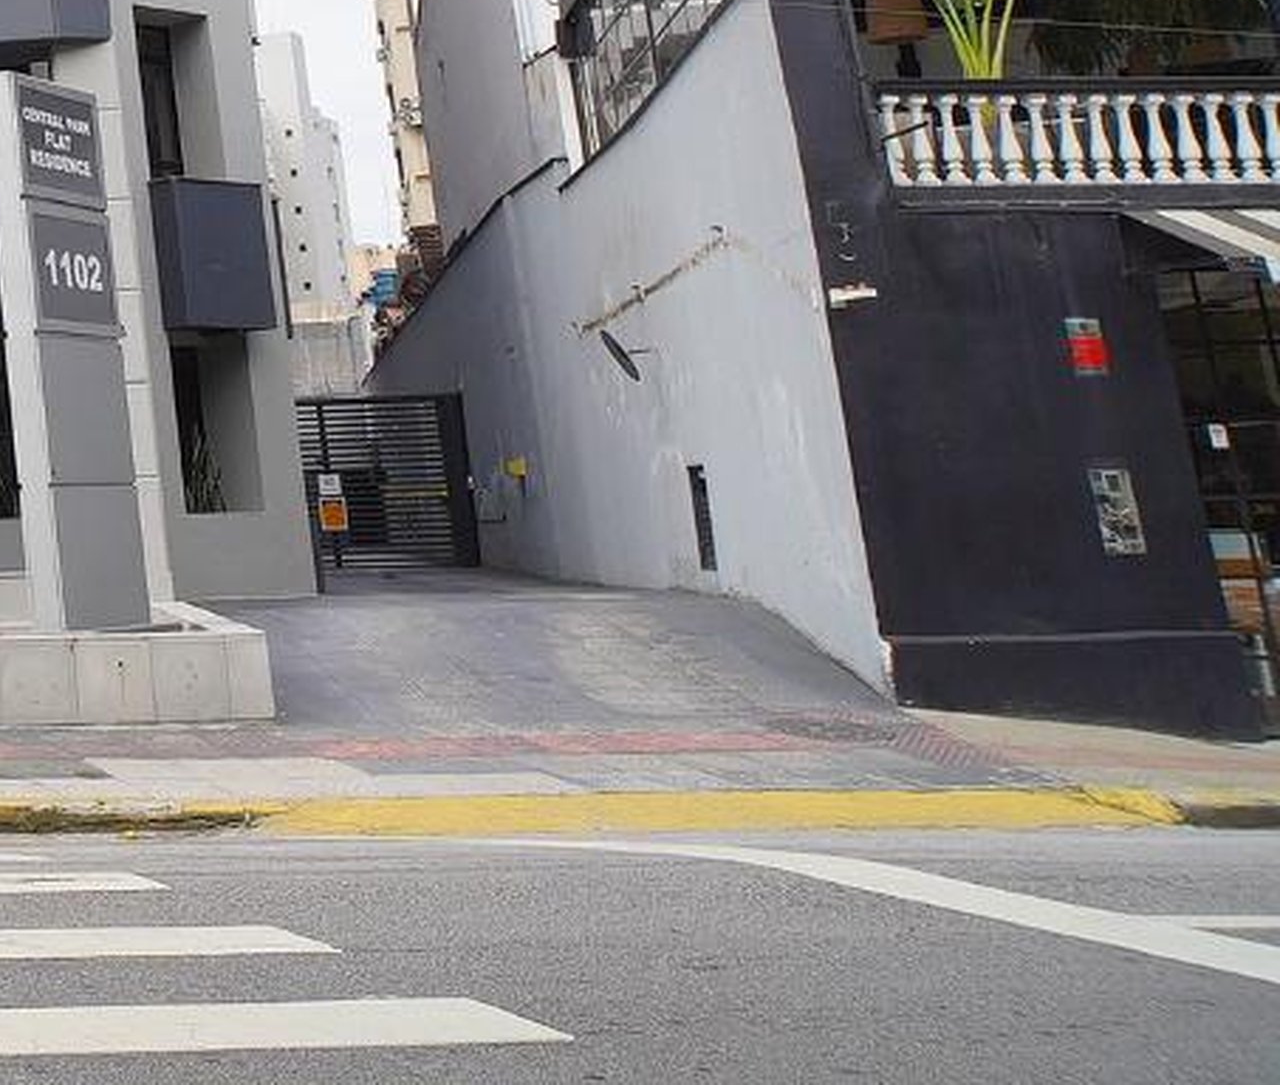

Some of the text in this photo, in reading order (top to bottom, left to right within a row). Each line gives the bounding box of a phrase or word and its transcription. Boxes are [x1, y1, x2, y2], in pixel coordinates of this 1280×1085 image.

[22, 106, 92, 137] CENTRAL PARK
[44, 129, 72, 152] FLAT
[30, 148, 92, 177] RESIDENCE
[44, 248, 104, 292] 1102
